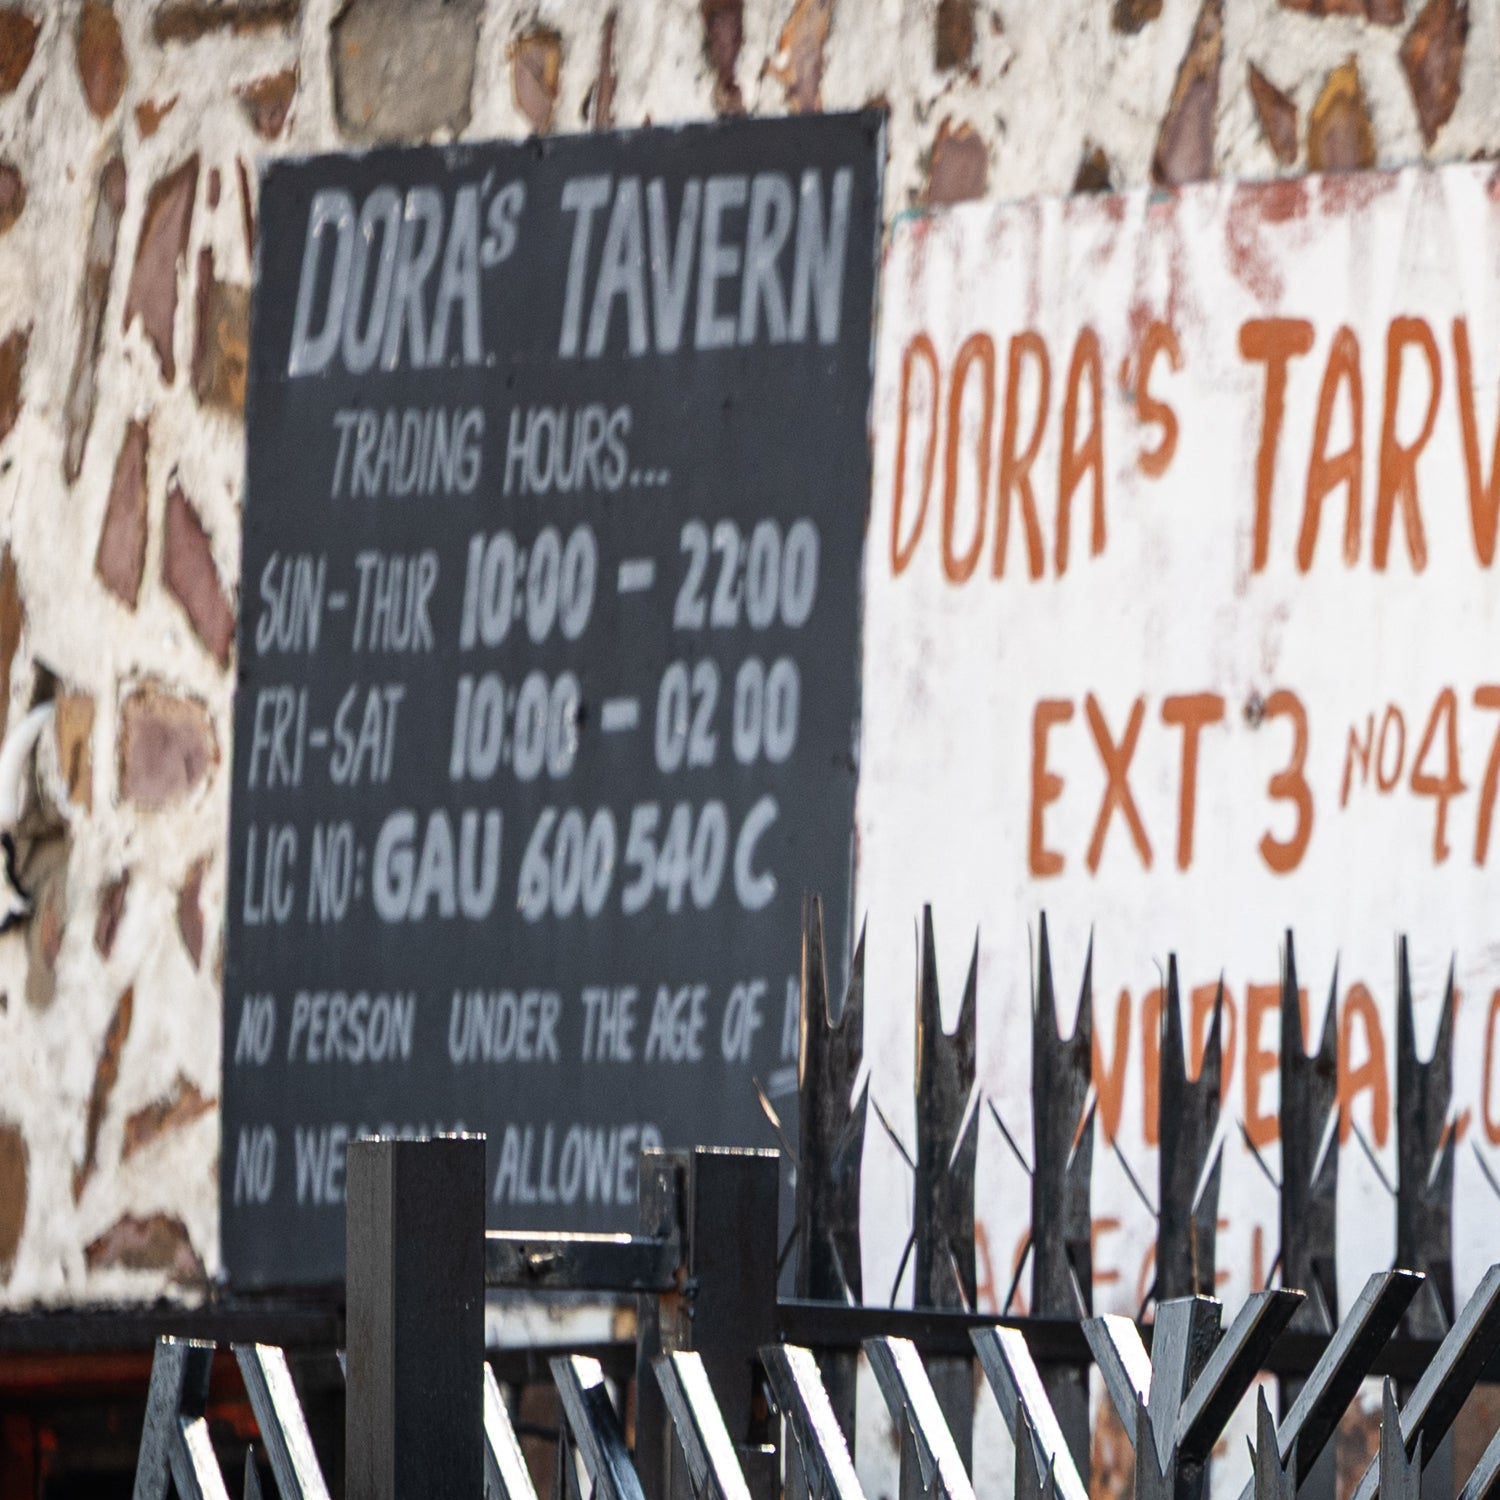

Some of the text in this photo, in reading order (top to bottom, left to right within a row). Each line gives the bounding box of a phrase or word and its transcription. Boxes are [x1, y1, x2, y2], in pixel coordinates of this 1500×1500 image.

[288, 166, 854, 378] DORA'S TAVERN
[330, 403, 486, 498] TRADING
[459, 522, 599, 652] 10:00
[449, 668, 582, 783] 10:00
[1027, 690, 1226, 880] EXT
[1259, 687, 1315, 875] 3
[243, 820, 298, 926] LIC
[372, 807, 504, 924] GAU
[234, 992, 277, 1064] NO
[287, 988, 417, 1064] PERSON
[447, 986, 563, 1064] UNDER
[582, 983, 637, 1062] THE
[644, 981, 709, 1064] AGE
[721, 975, 769, 1063] OF
[234, 1122, 276, 1207] NO
